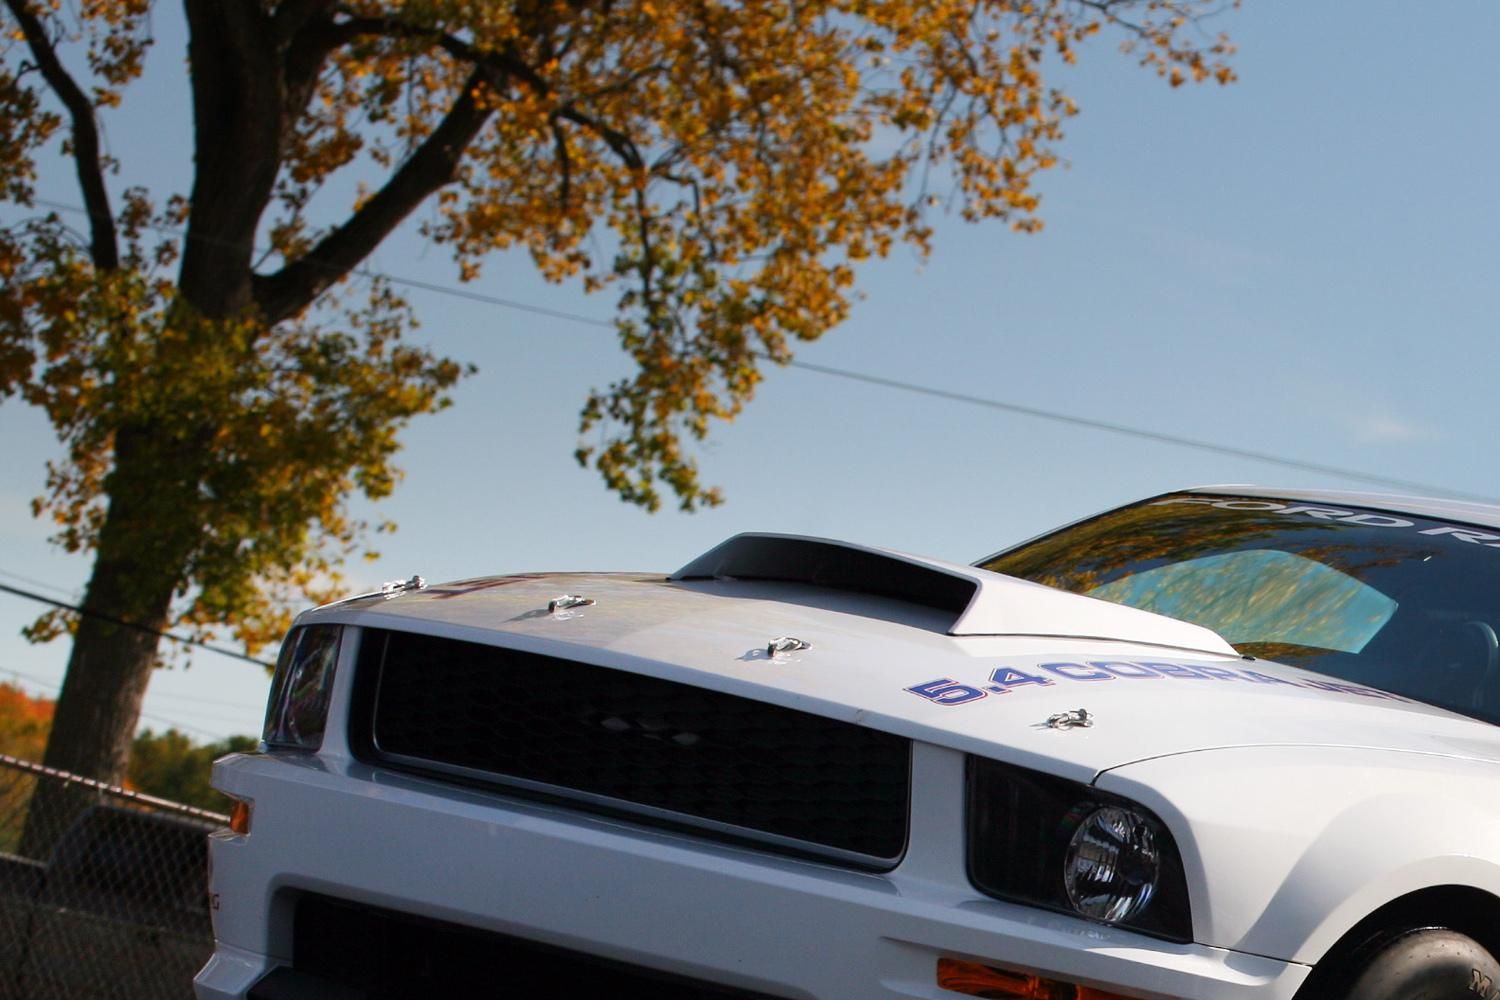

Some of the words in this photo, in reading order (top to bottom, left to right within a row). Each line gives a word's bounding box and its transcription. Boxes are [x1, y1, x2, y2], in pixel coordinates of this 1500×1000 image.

[1150, 497, 1415, 528] FORD
[902, 664, 1056, 706] 5.4
[1036, 659, 1307, 690] COBRA
